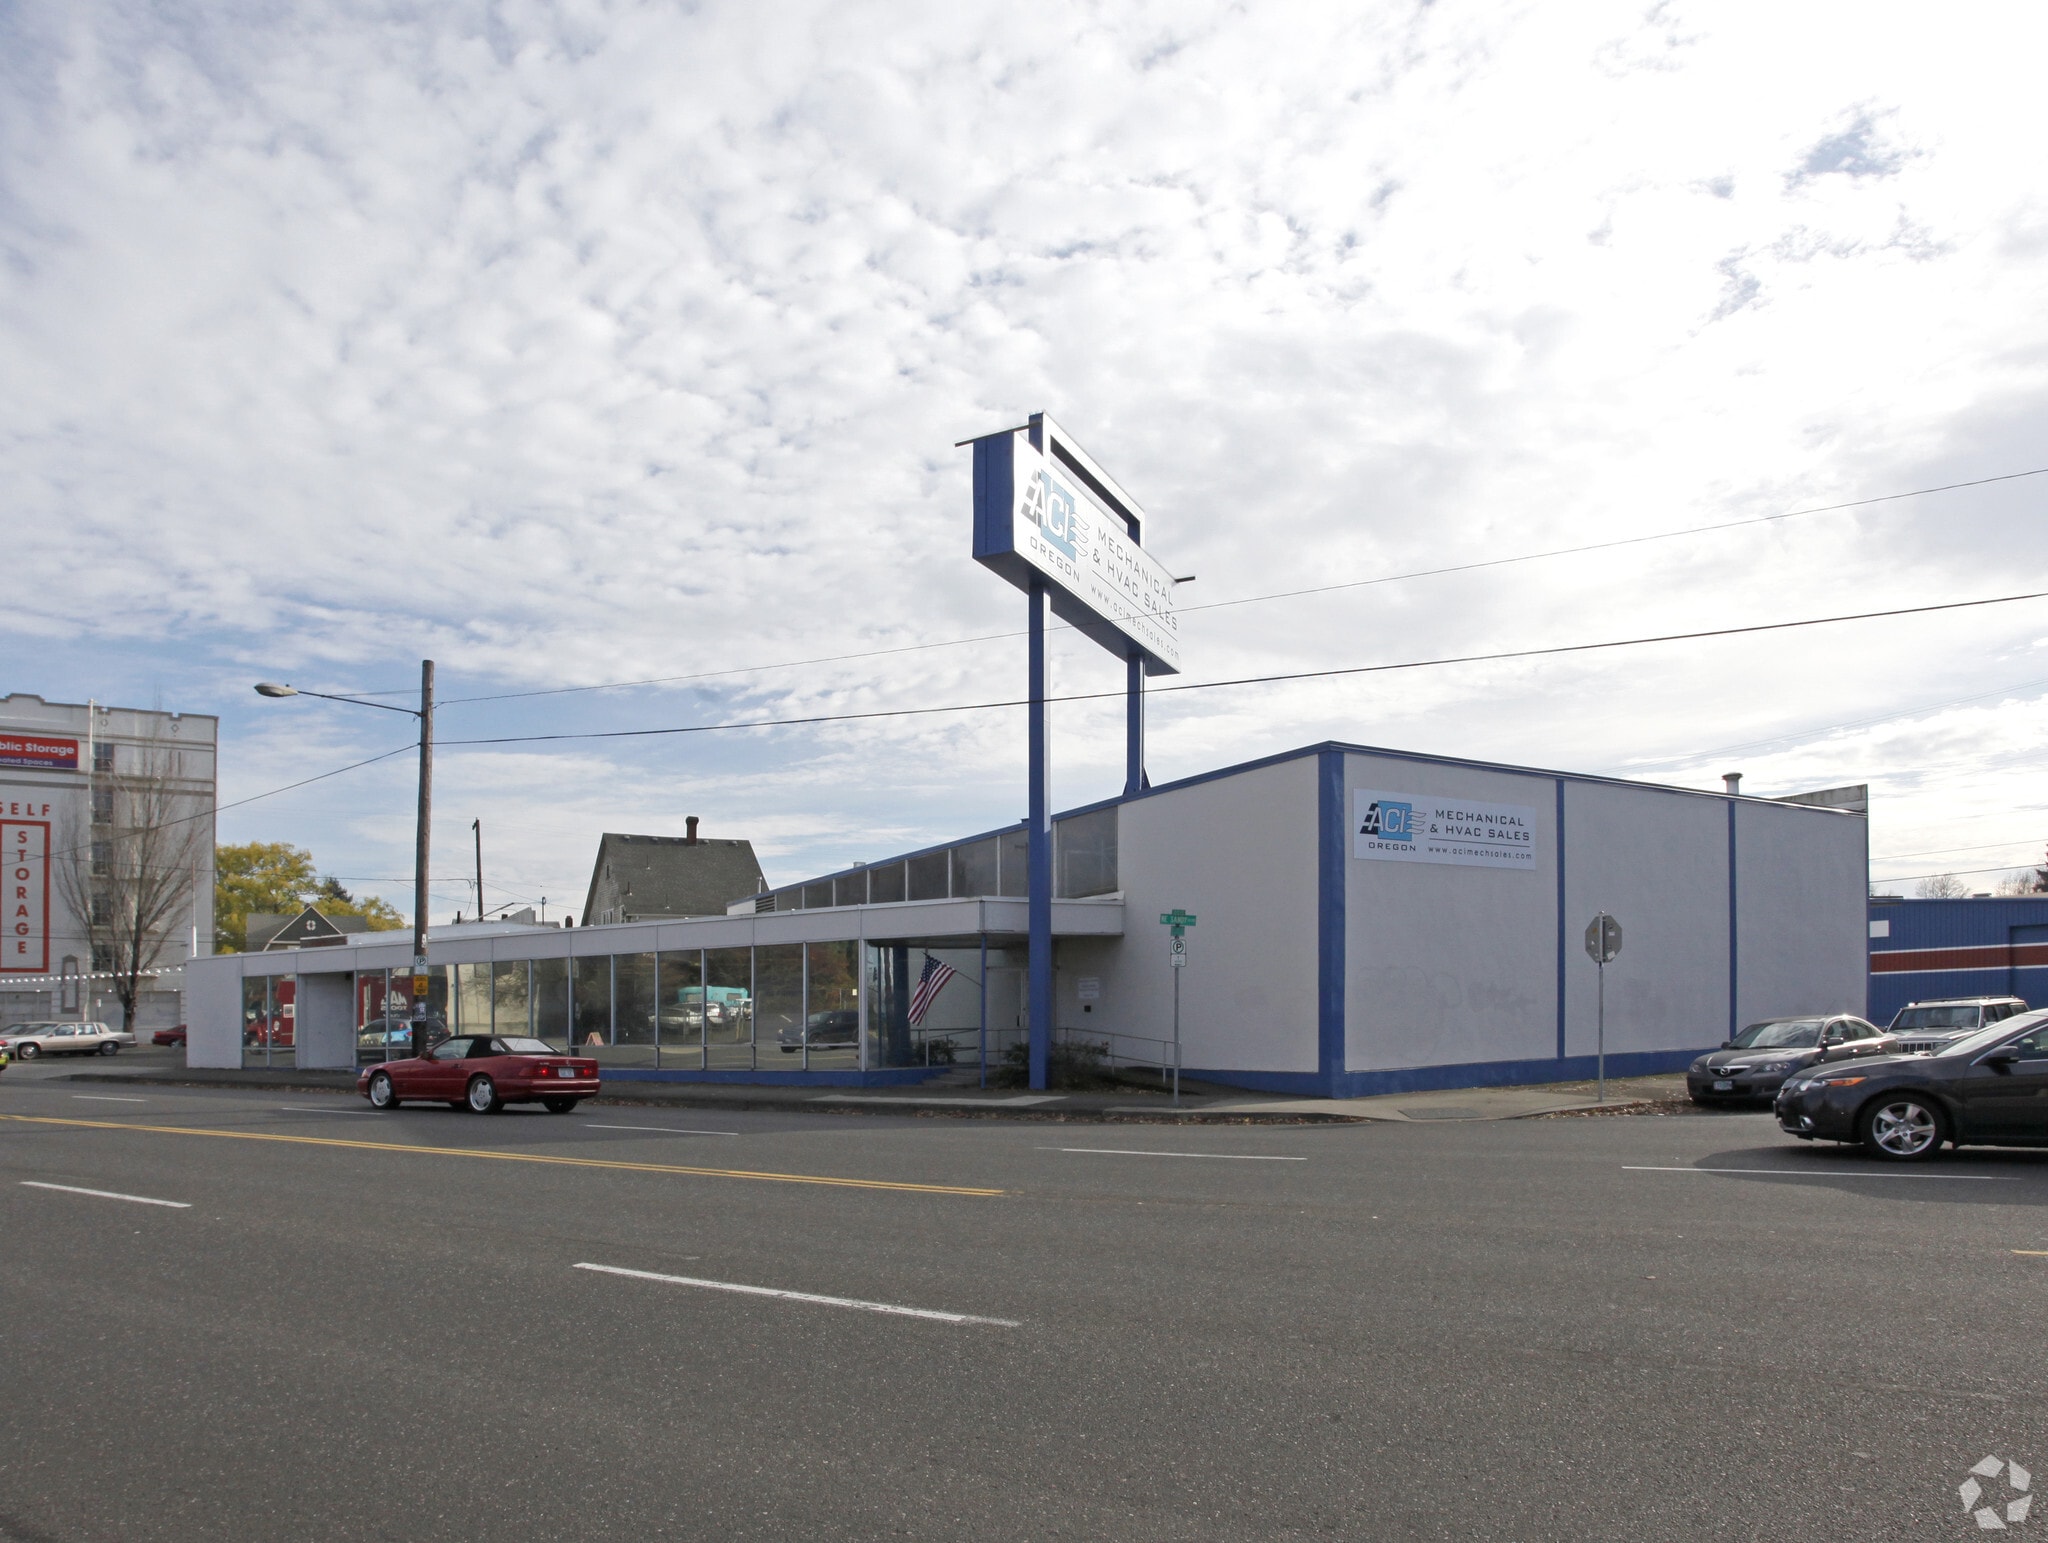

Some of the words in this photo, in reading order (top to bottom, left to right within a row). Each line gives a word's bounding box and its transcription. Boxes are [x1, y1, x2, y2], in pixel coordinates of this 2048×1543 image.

[1029, 536, 1081, 584] OREGON
[1097, 526, 1174, 607] MECHANICAL
[1092, 548, 1101, 566] &
[1107, 559, 1139, 598] HVAC
[1144, 593, 1178, 631] SALES
[25, 743, 75, 756] Storage
[23, 758, 53, 767] Spaces
[1435, 809, 1524, 826] MECHANICAL
[1430, 824, 1438, 833] &
[1446, 825, 1481, 837] HVAC
[1488, 829, 1530, 841] SALES
[1368, 841, 1416, 851] OREGON
[1428, 846, 1532, 860] www.acimechsales.com
[15, 830, 30, 954] STORAGE
